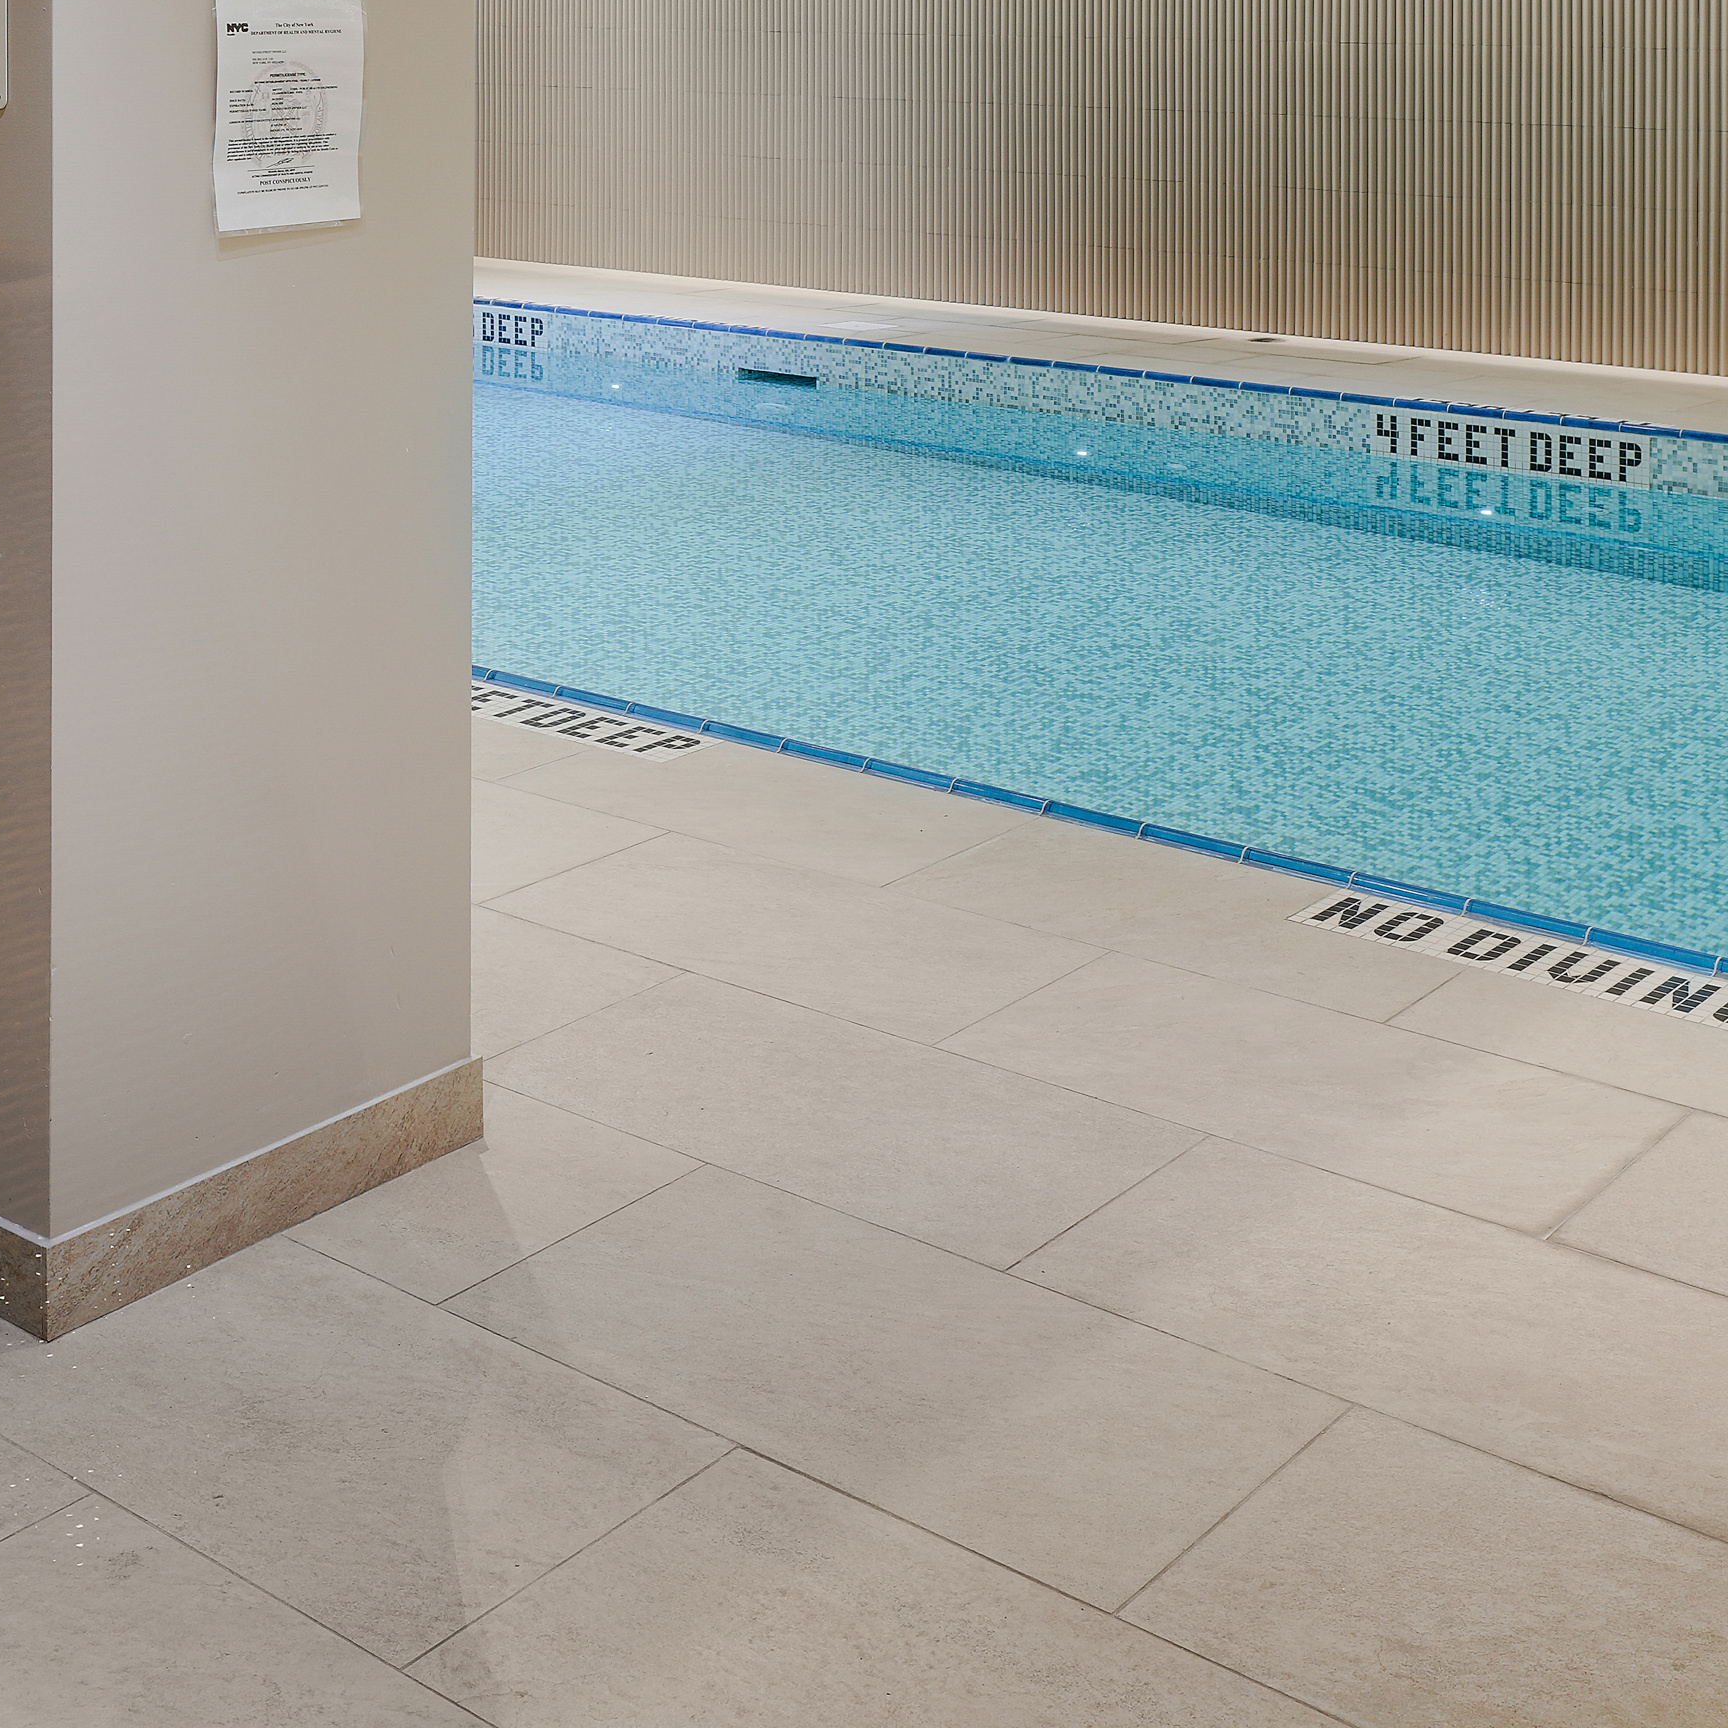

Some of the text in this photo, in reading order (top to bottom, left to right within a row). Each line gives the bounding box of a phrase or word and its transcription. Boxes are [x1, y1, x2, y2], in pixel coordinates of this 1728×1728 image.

[227, 23, 248, 32] NYC
[273, 177, 311, 185] CONSPICUOUSLY
[482, 312, 544, 347] DEEP
[1376, 413, 1642, 483] 4 FEET DEEP
[519, 708, 701, 753] DEEP
[1311, 898, 1444, 943] NO
